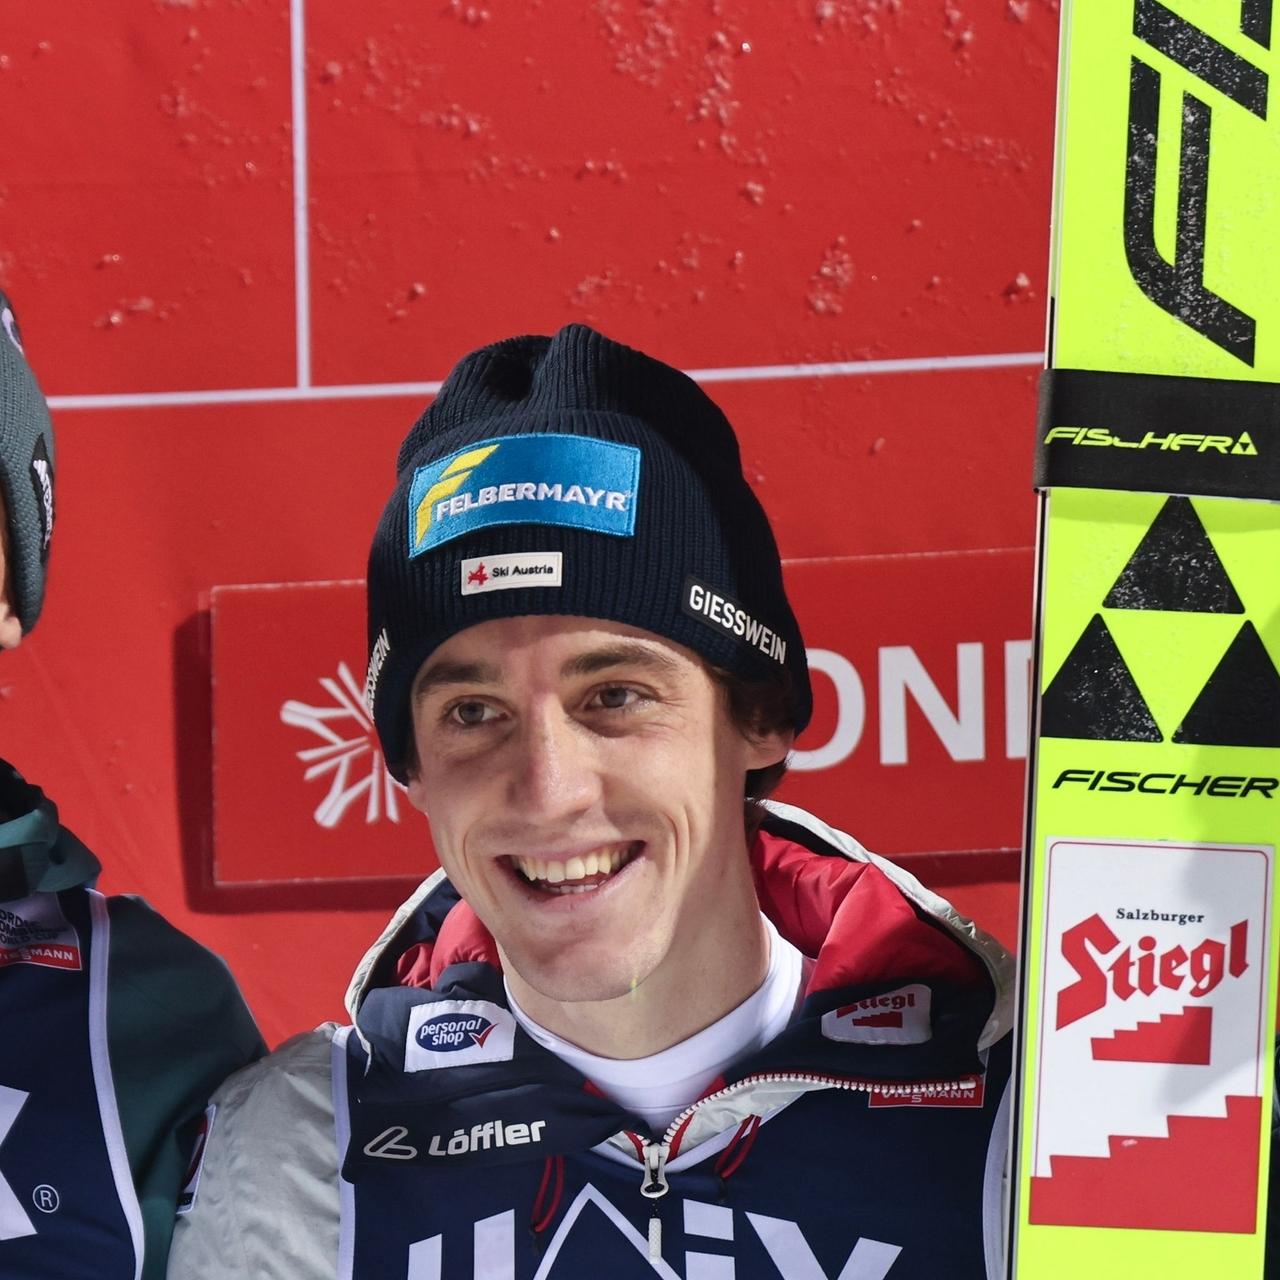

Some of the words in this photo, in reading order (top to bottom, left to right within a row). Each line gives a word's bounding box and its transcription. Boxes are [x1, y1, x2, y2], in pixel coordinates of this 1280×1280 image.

[436, 482, 626, 522] FELBERMAYR
[491, 565, 510, 578] Ski
[512, 562, 554, 576] Austria
[689, 585, 787, 665] GIESSWEIN
[1051, 768, 1280, 799] FISCHER
[1116, 908, 1205, 926] Salzburger
[1055, 913, 1250, 1031] Stiegl
[420, 1018, 483, 1039] personal
[432, 1031, 464, 1046] shop
[429, 1118, 547, 1158] Löffler
